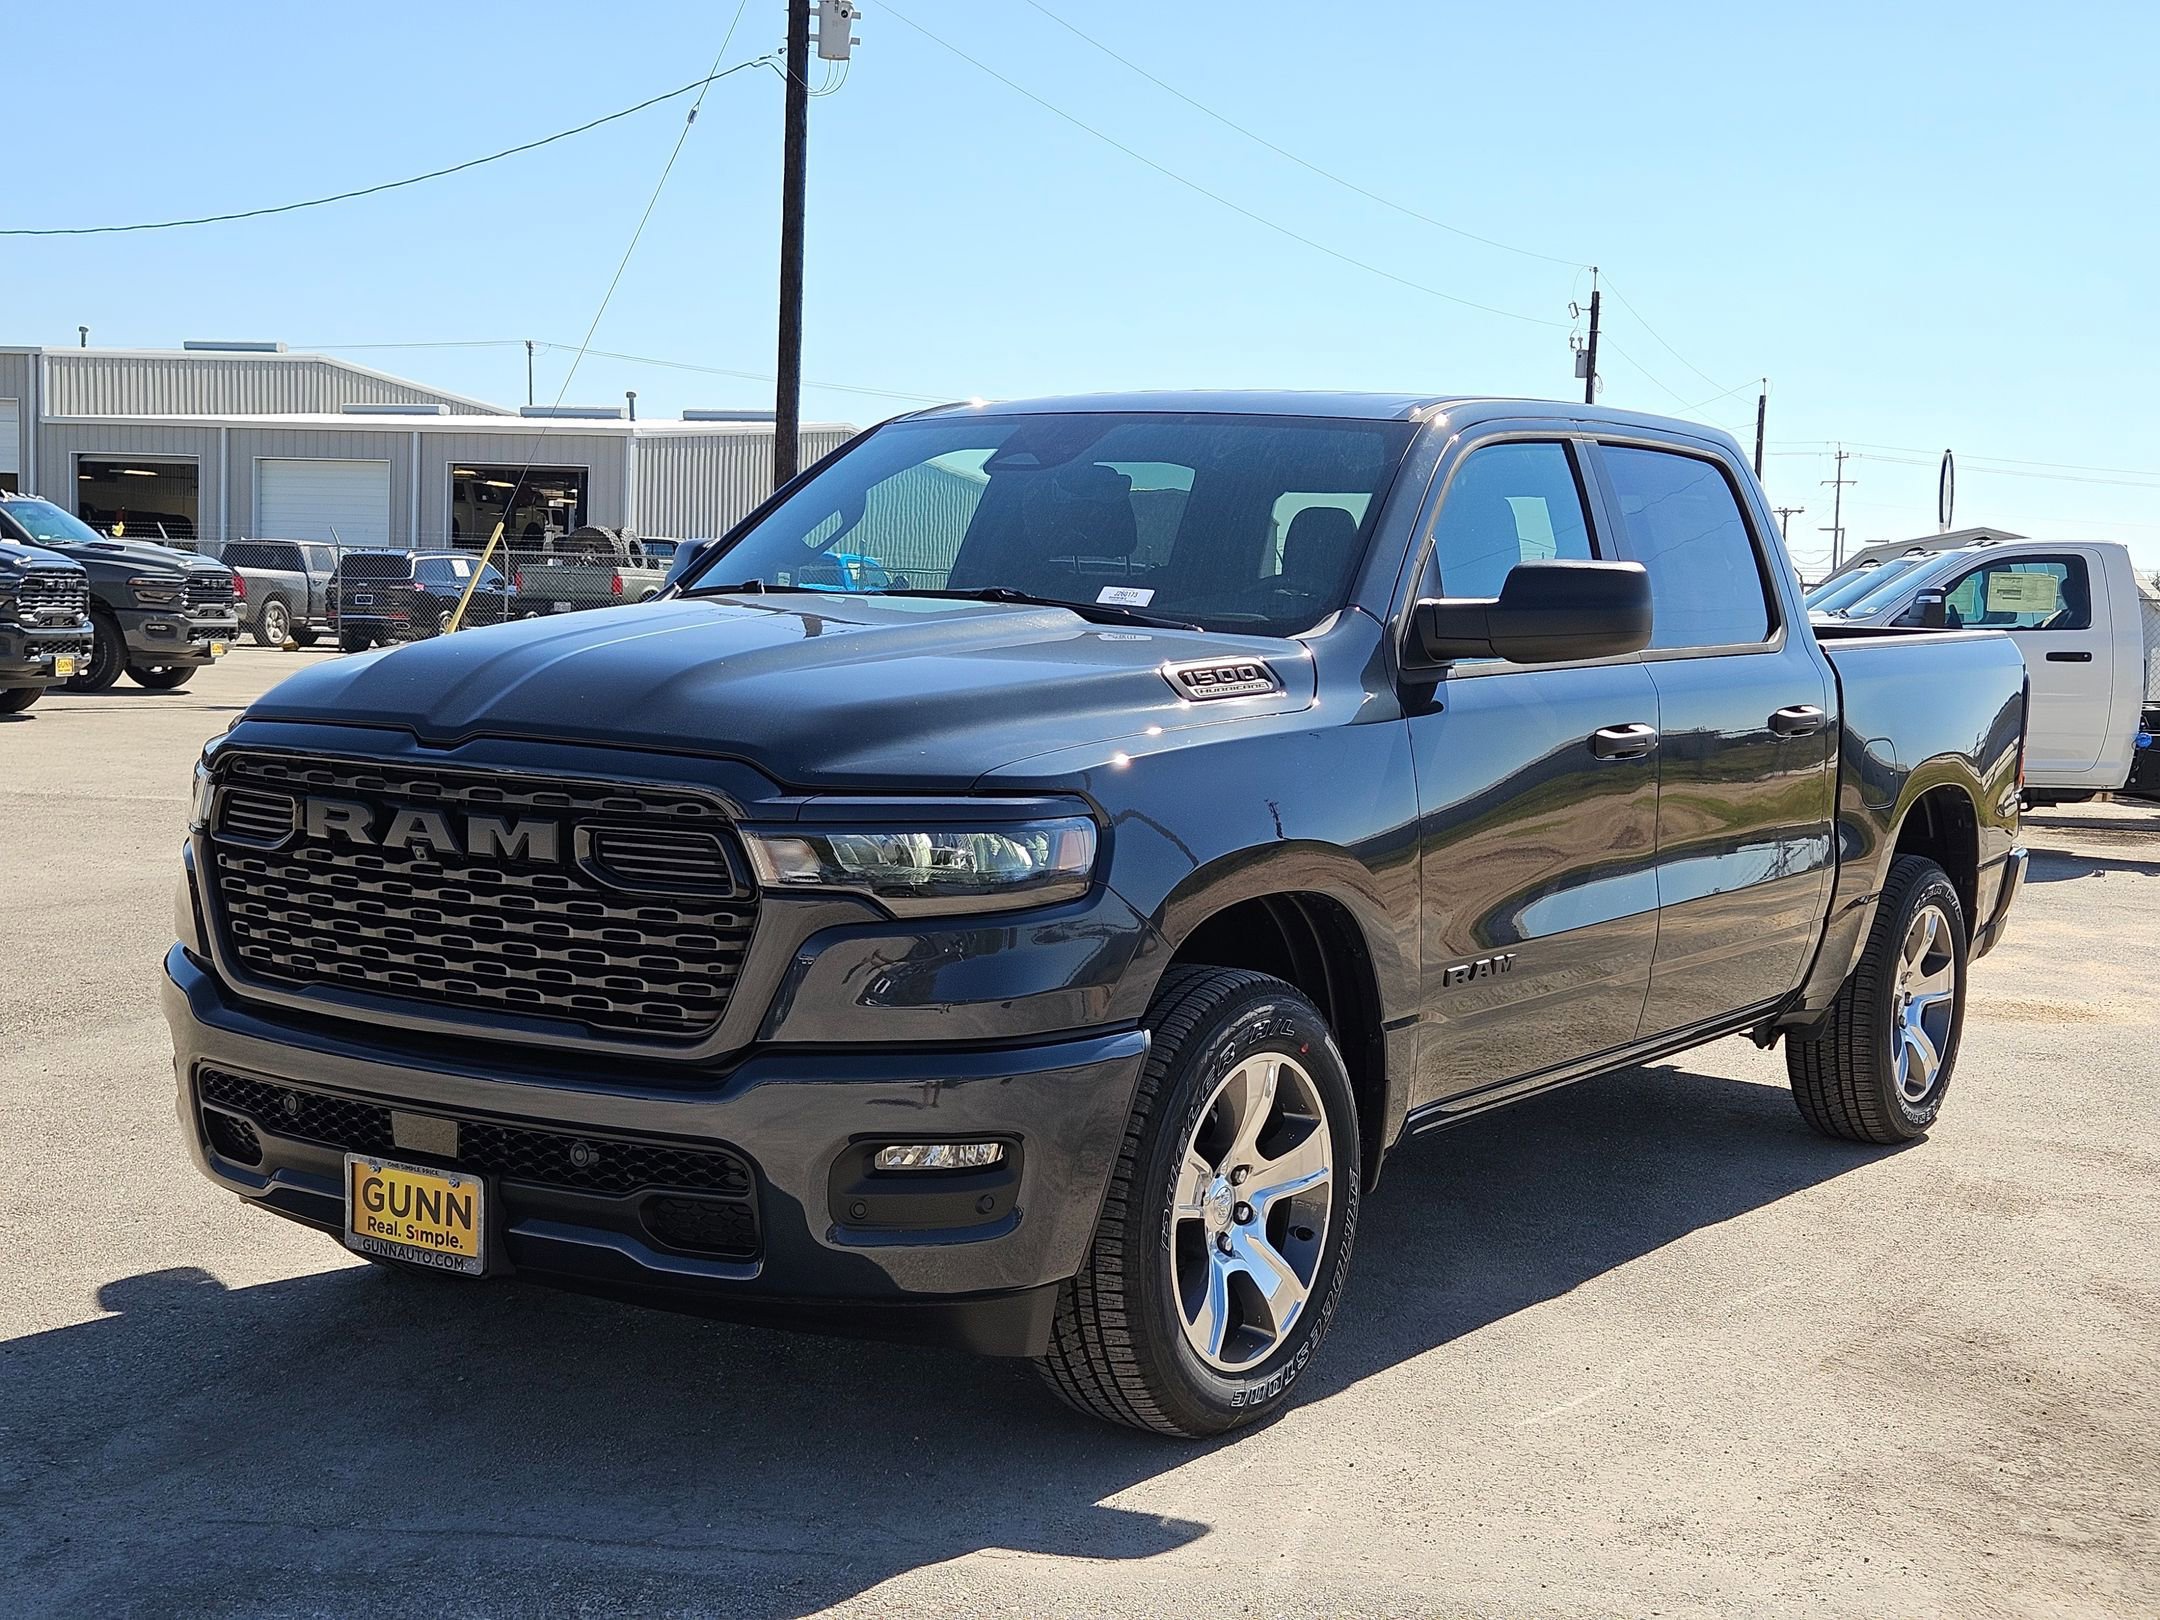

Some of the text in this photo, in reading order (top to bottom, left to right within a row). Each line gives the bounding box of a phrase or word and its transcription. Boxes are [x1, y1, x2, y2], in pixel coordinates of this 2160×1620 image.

[1183, 665, 1259, 686] 1500
[306, 796, 560, 863] RAM
[1443, 953, 1518, 988] RAM
[1249, 1018, 1296, 1045] H/L
[362, 1176, 472, 1230] GUNN
[367, 1215, 402, 1238] Real.
[362, 1238, 465, 1271] GUNNAUTO.COM
[1231, 1167, 1360, 1408] BRIDGESTONE
